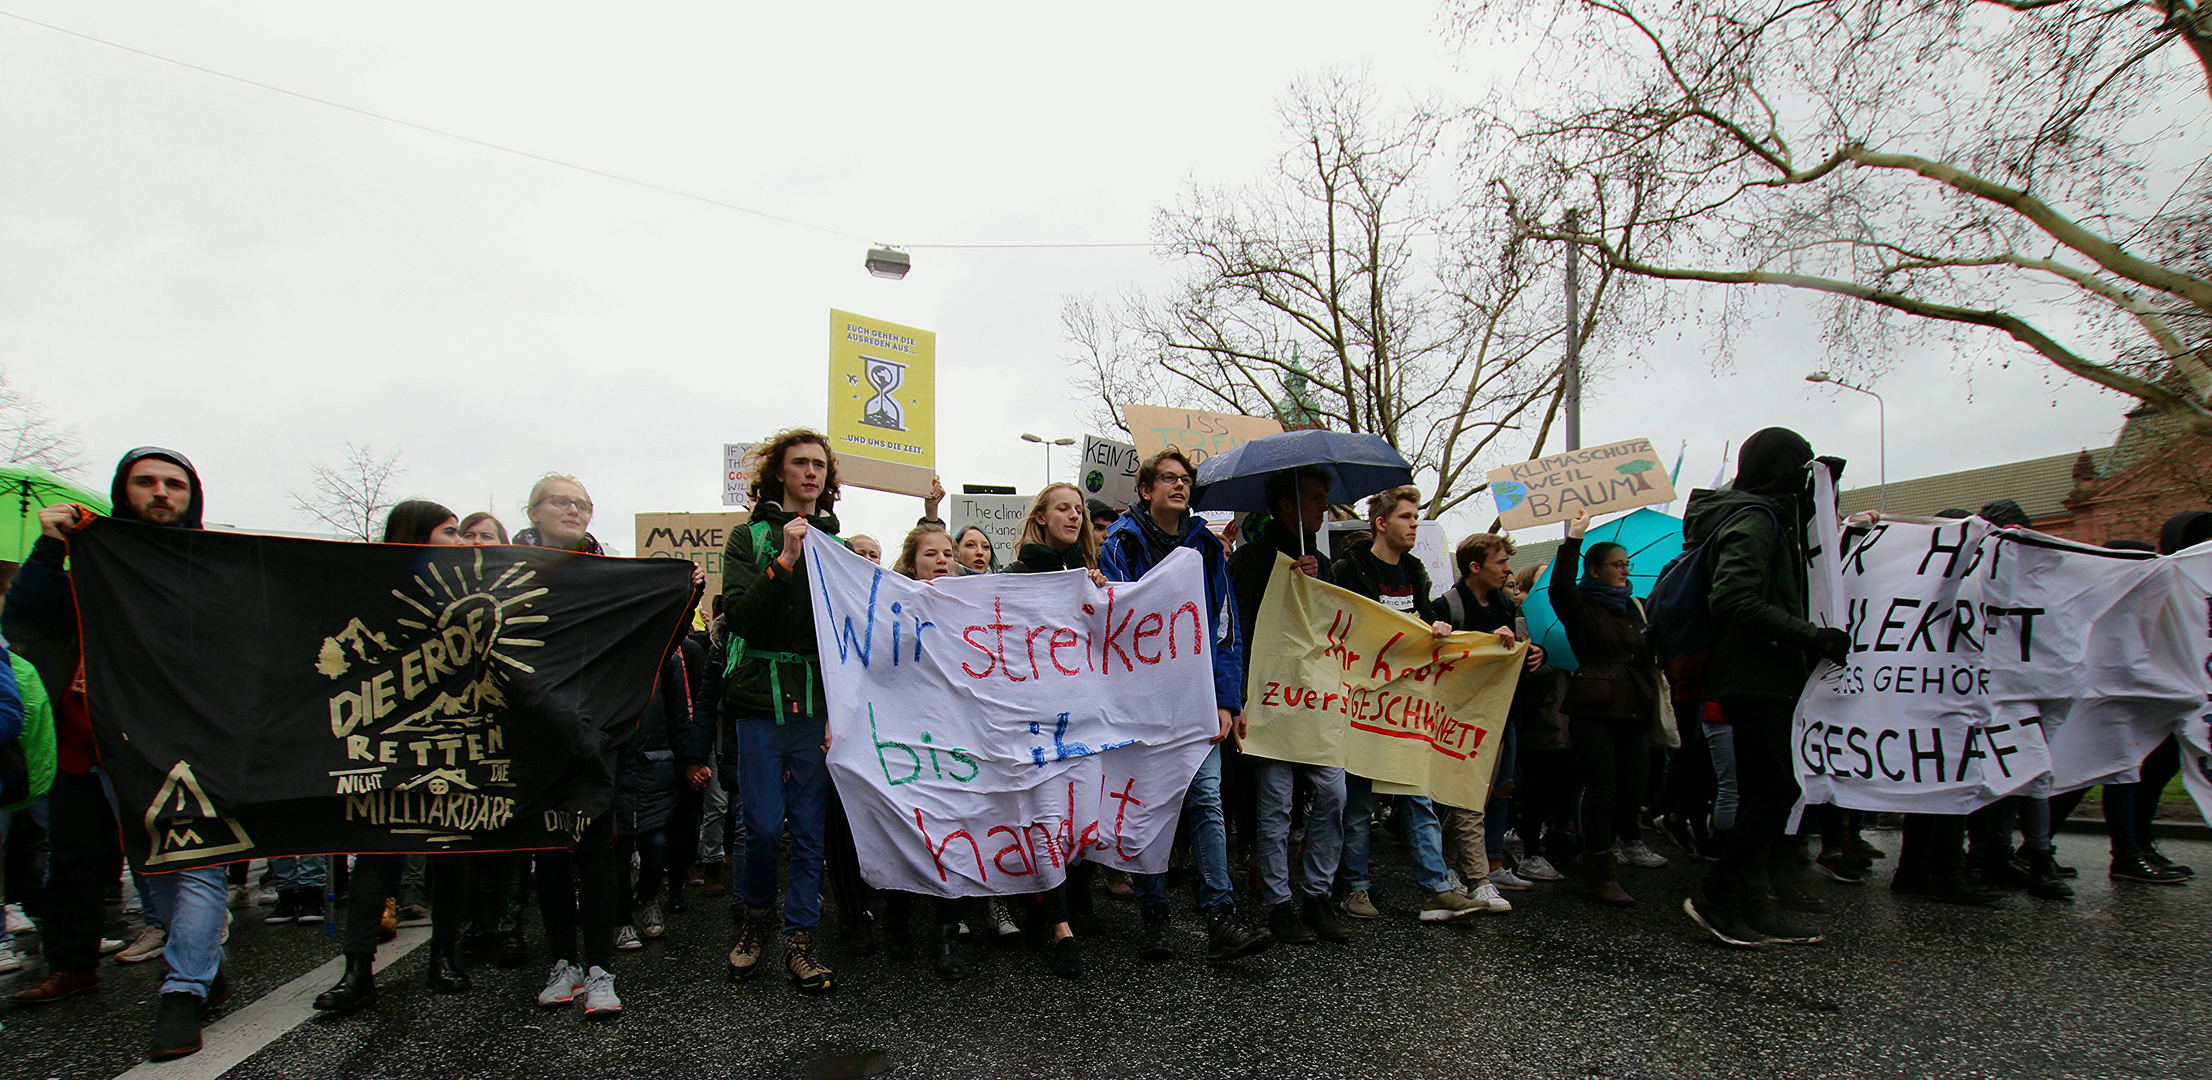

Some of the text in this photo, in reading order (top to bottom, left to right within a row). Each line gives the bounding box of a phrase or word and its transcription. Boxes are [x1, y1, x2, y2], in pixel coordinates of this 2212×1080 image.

[847, 324, 916, 346] EUCH GEHEN DIE
[847, 333, 890, 349] AUSREDEN
[1187, 414, 1229, 435] ISS
[728, 446, 738, 456] IF
[868, 438, 886, 448] UNS
[888, 442, 902, 451] DIE
[904, 445, 924, 455] ZEIT.
[1086, 436, 1123, 468] KEIN
[1511, 440, 1653, 481] KLIMASCHUTZ
[1524, 468, 1593, 491] WEIL
[728, 493, 744, 503] TO
[1527, 477, 1637, 518] BAUM
[963, 501, 991, 519] The
[645, 527, 723, 548] MAKE
[813, 546, 1202, 682] Wir streiken
[329, 608, 484, 738] DIE ERDE
[347, 725, 504, 766] RETTEN
[869, 702, 1135, 786] bis ih
[336, 764, 509, 794] NICHT DIE
